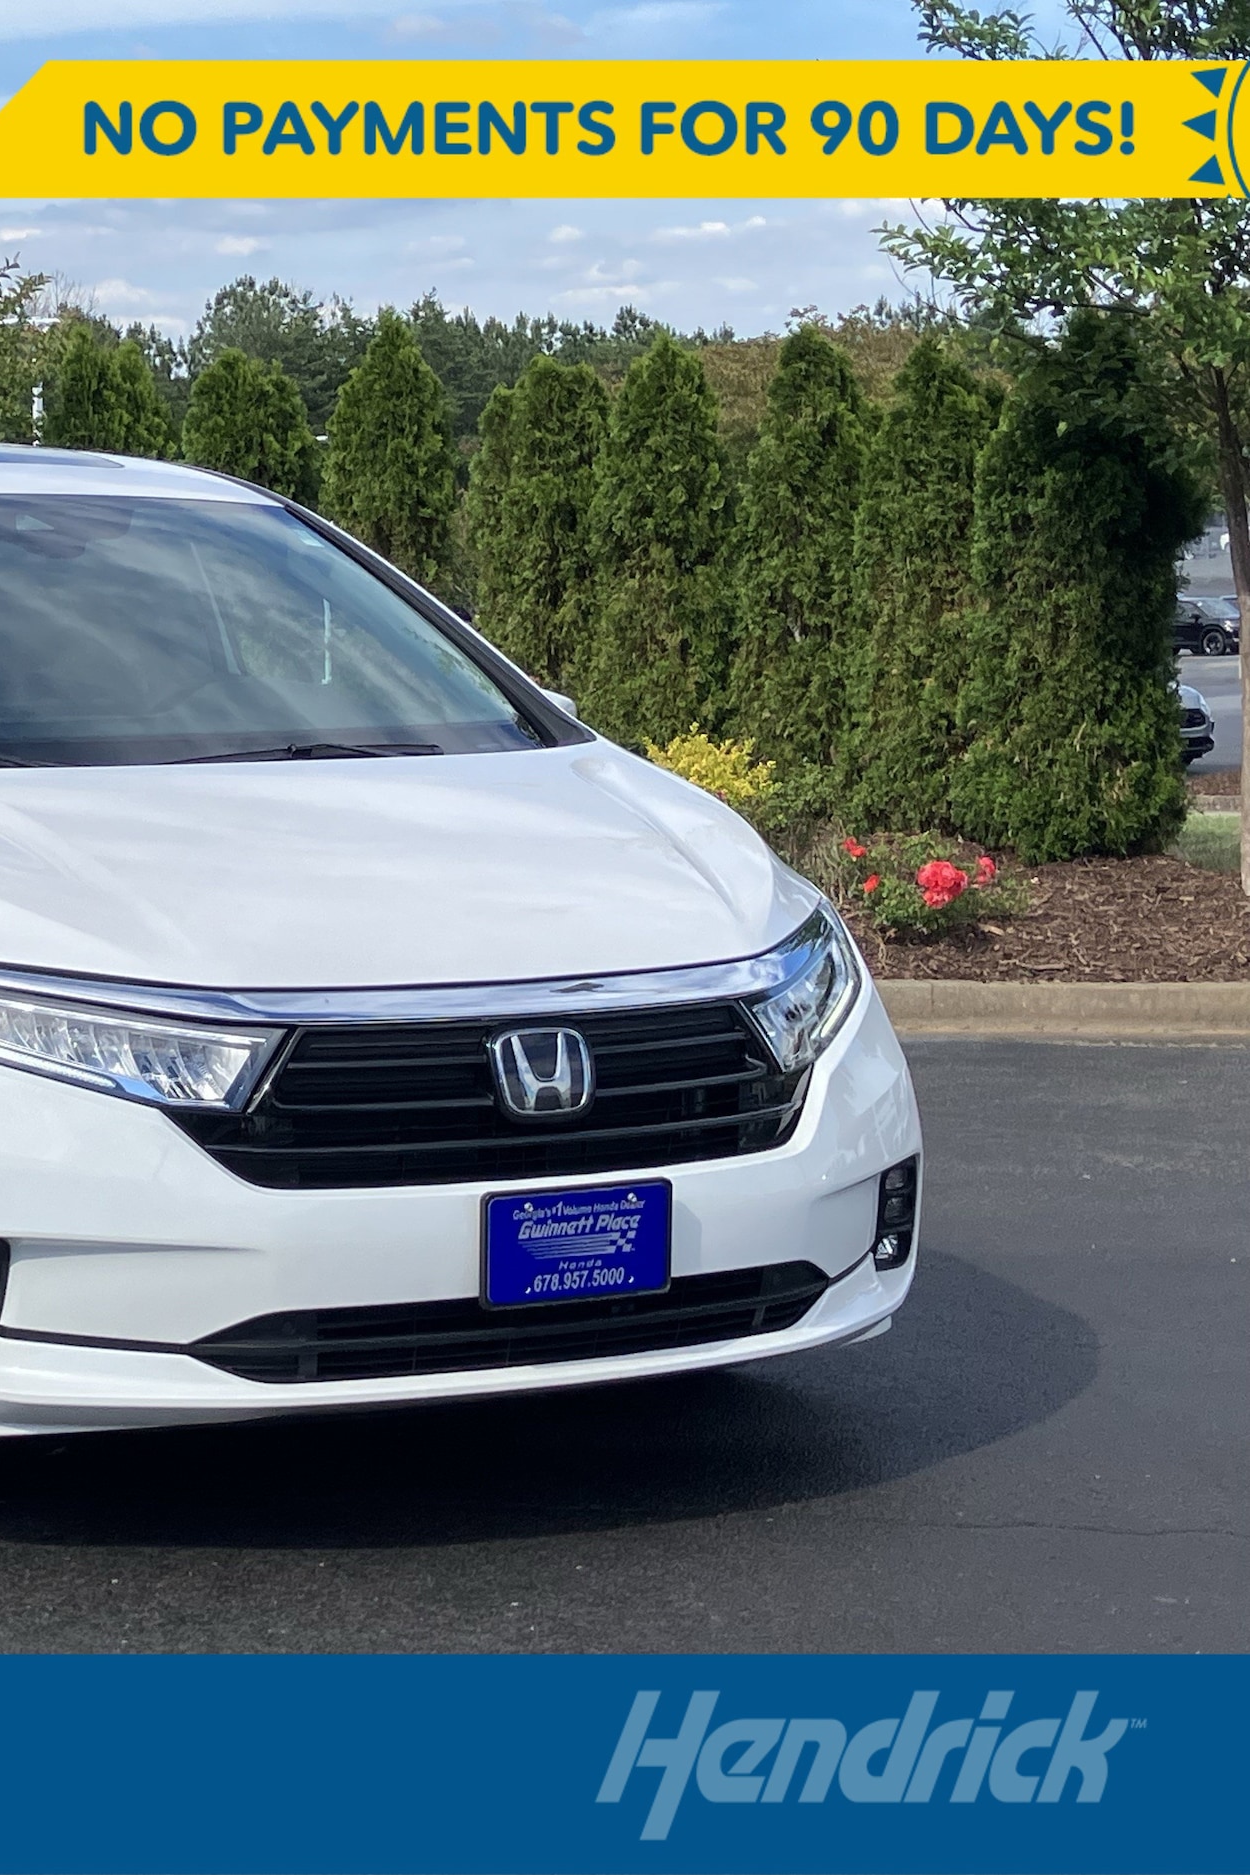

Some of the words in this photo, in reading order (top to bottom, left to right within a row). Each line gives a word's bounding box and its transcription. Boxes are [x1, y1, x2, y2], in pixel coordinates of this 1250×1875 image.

[593, 1201, 618, 1213] Honda
[518, 1215, 594, 1239] Gwinnett
[595, 1213, 641, 1231] Place
[558, 1258, 603, 1271] Honda
[533, 1267, 625, 1293] 678.957.5000
